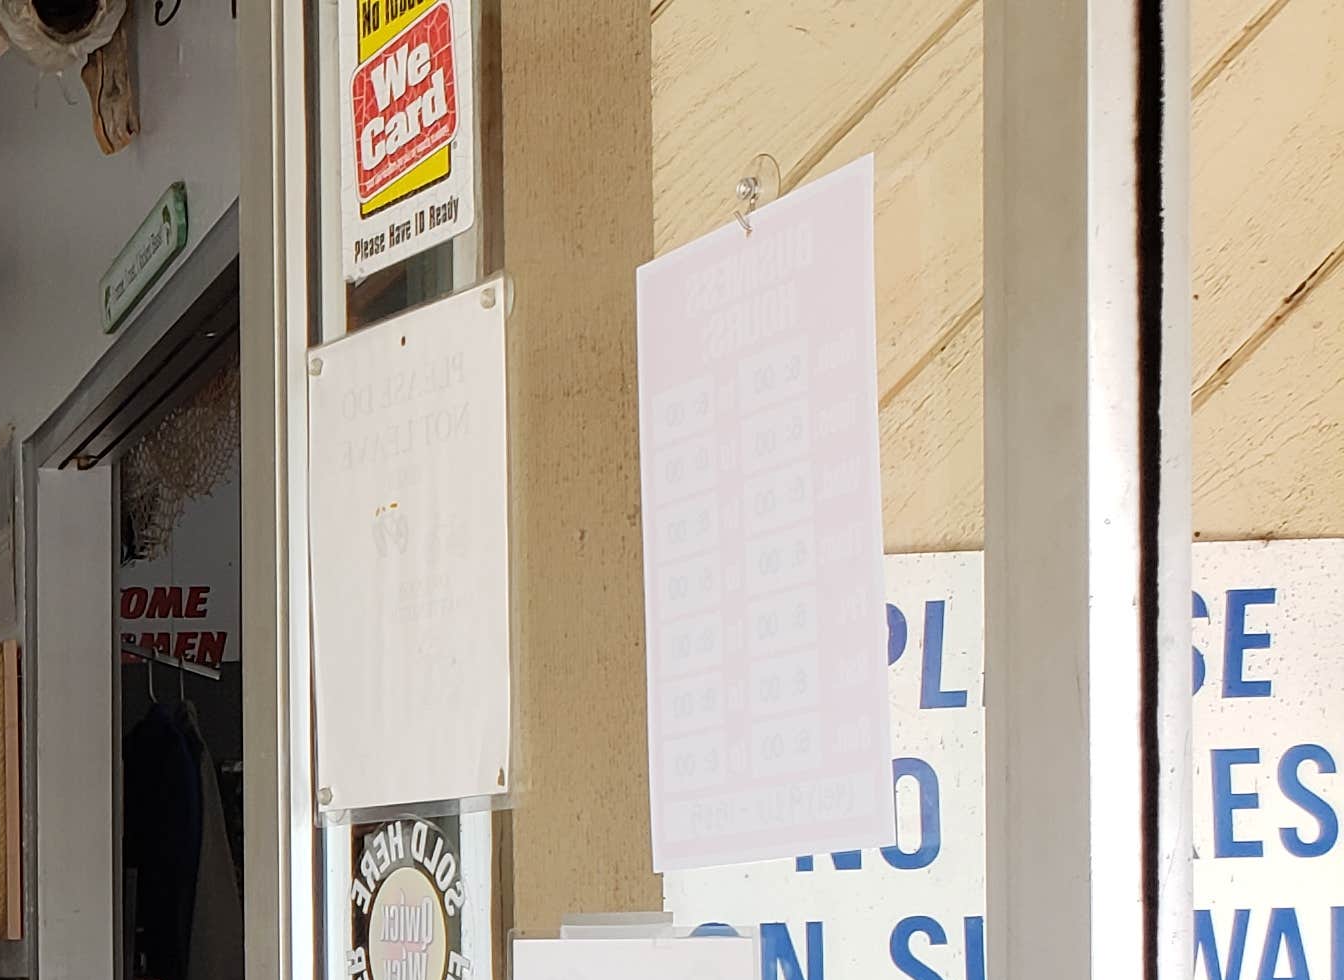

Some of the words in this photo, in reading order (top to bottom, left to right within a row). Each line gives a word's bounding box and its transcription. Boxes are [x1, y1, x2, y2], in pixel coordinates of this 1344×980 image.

[362, 3, 379, 38] No
[371, 42, 431, 112] We
[362, 69, 448, 171] Card
[354, 232, 385, 264] Please
[389, 219, 411, 248] Have
[414, 212, 425, 237] ID
[429, 196, 459, 231] Ready
